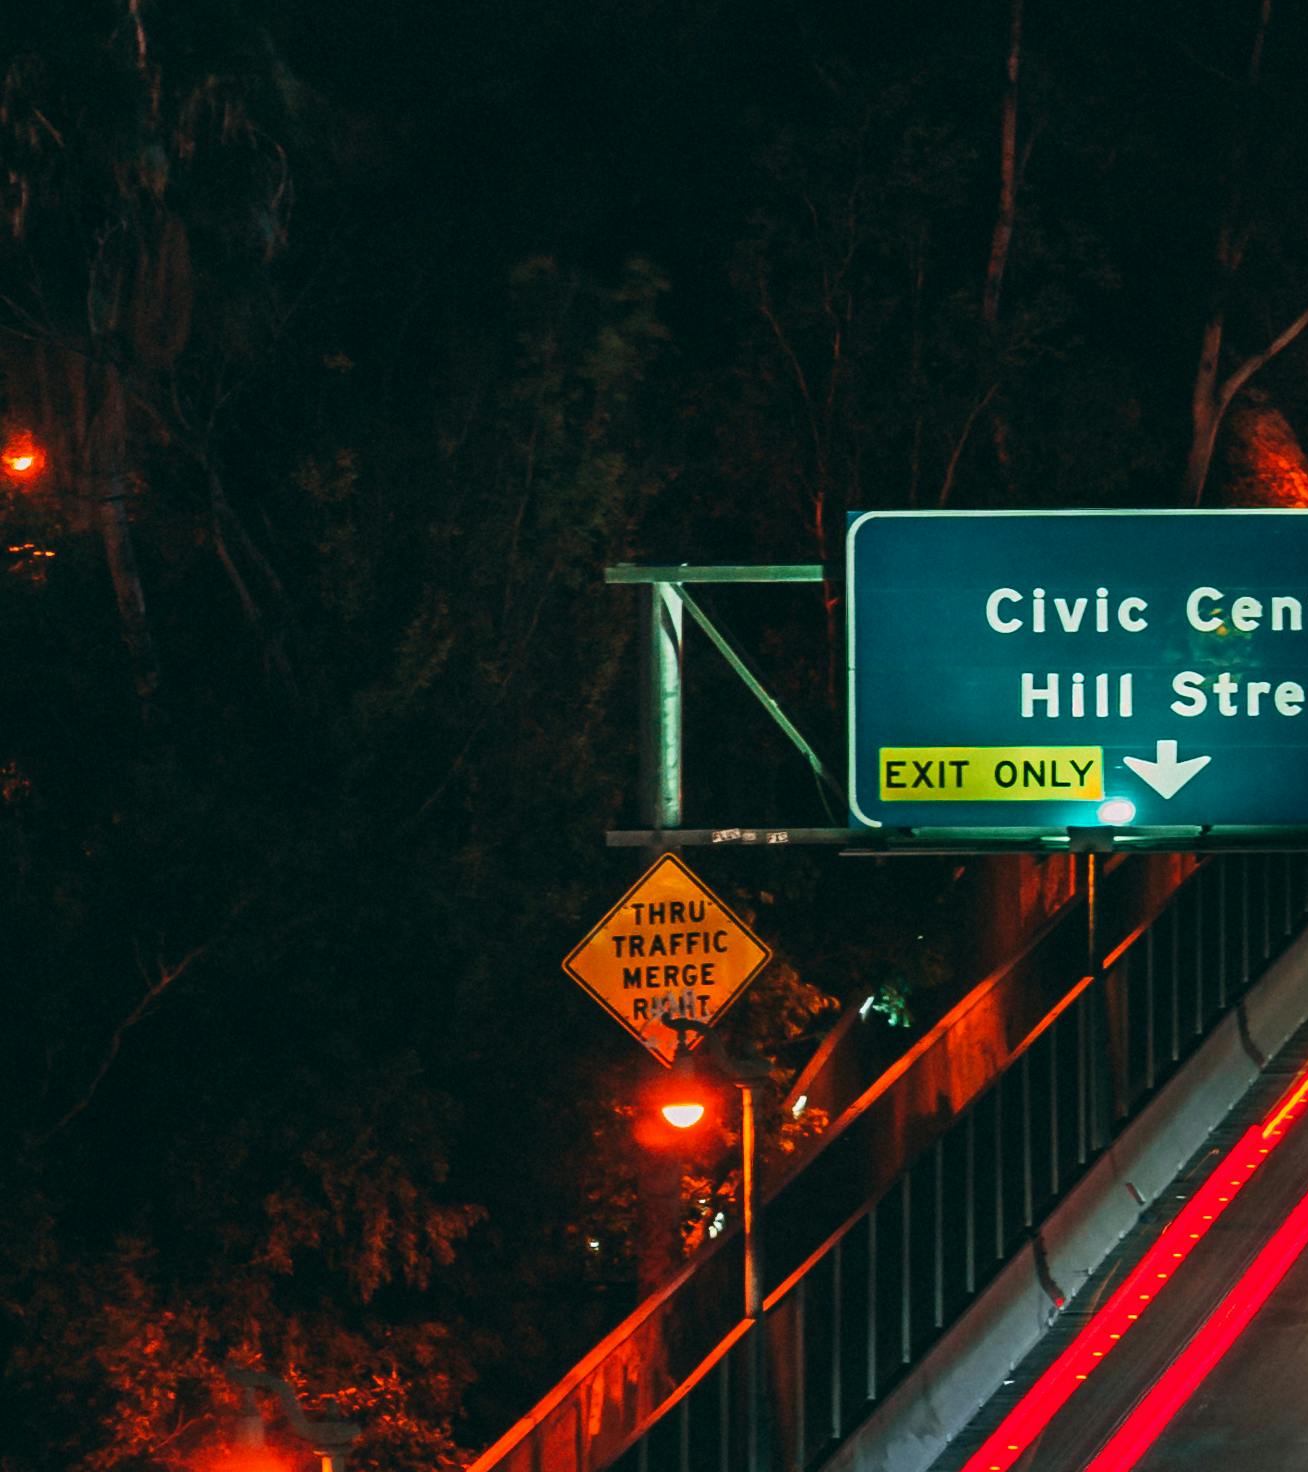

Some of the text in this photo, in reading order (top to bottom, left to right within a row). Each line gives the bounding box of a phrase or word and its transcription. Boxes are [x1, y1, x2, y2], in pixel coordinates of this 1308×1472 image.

[985, 587, 1149, 634] Civic
[1021, 672, 1133, 718] Hill
[885, 759, 1094, 789] EXIT ONLY
[630, 900, 704, 925] THRU
[612, 930, 728, 958] TRAFFIC
[623, 963, 715, 989] MERGE
